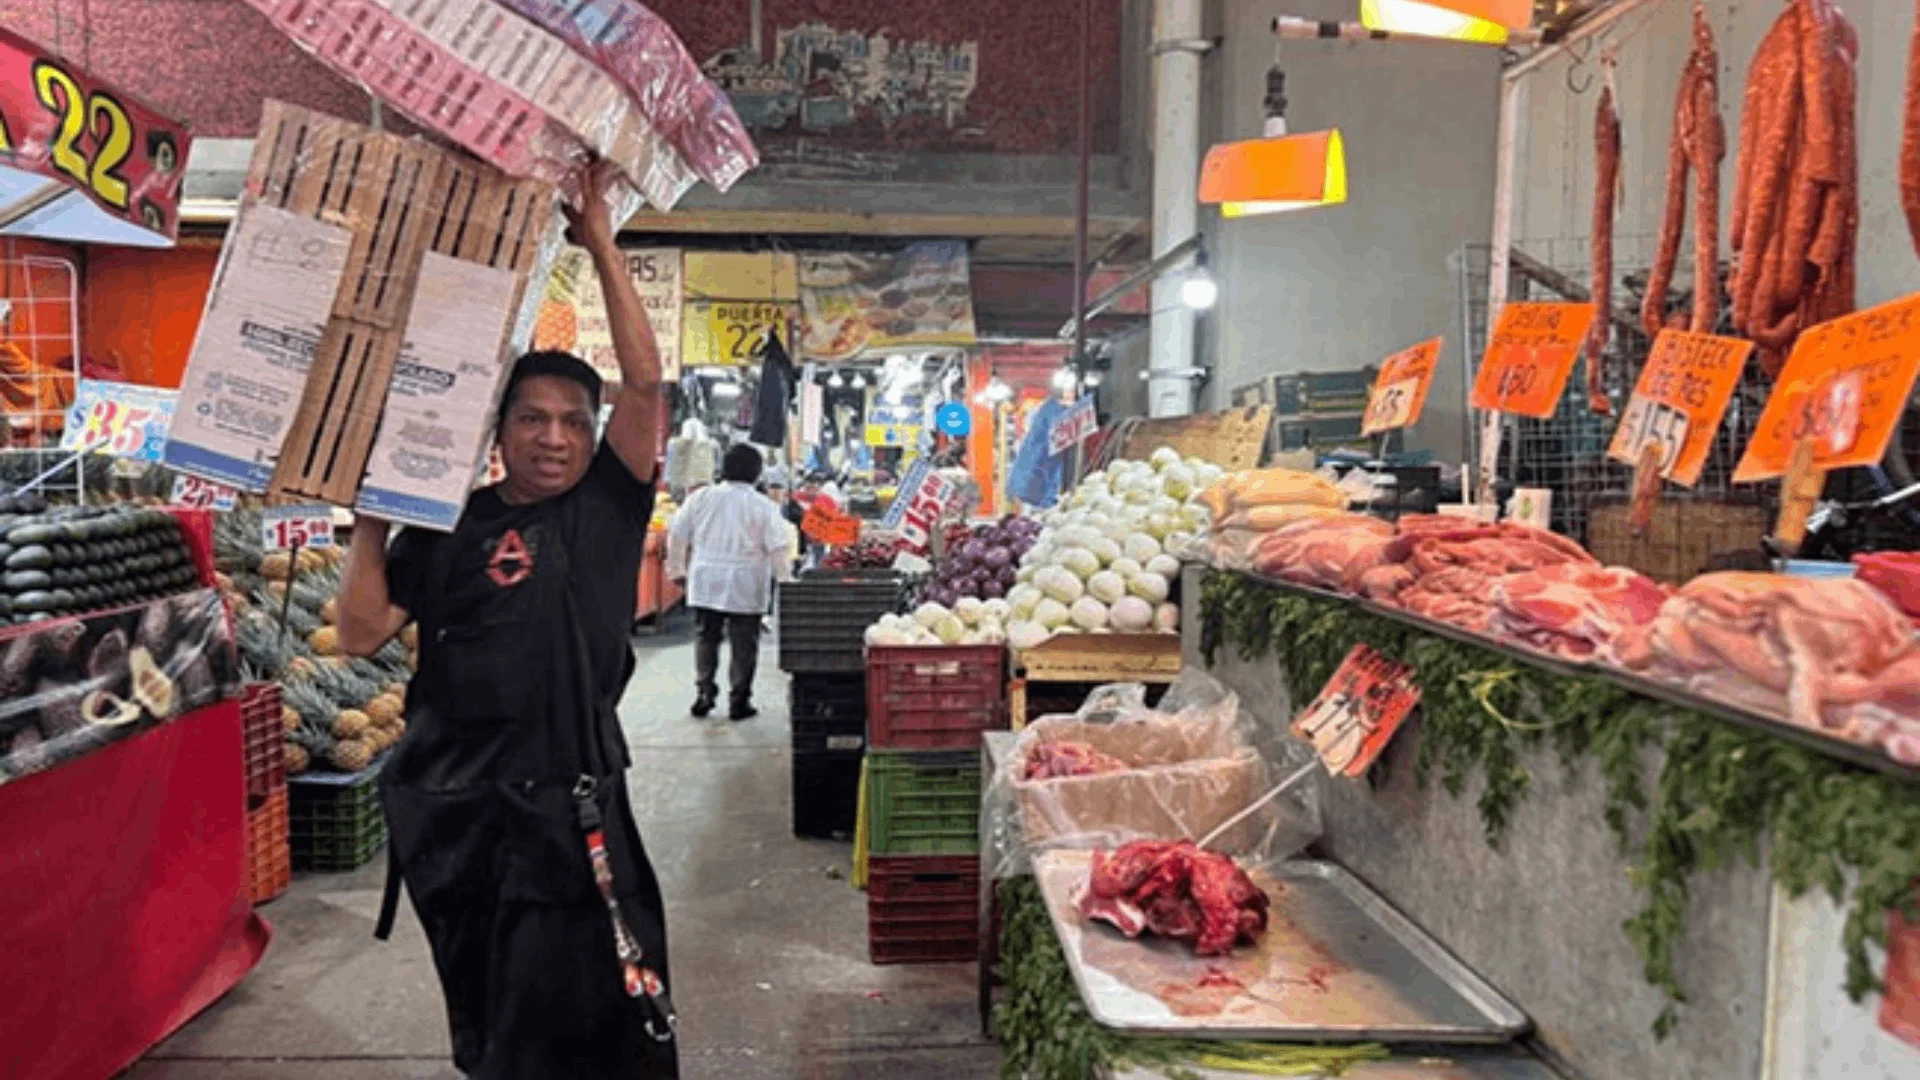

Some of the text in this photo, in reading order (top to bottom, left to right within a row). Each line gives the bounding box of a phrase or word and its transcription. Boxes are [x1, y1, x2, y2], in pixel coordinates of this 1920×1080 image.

[33, 60, 132, 211] 22
[626, 255, 657, 281] AS
[717, 306, 784, 321] PUERTA
